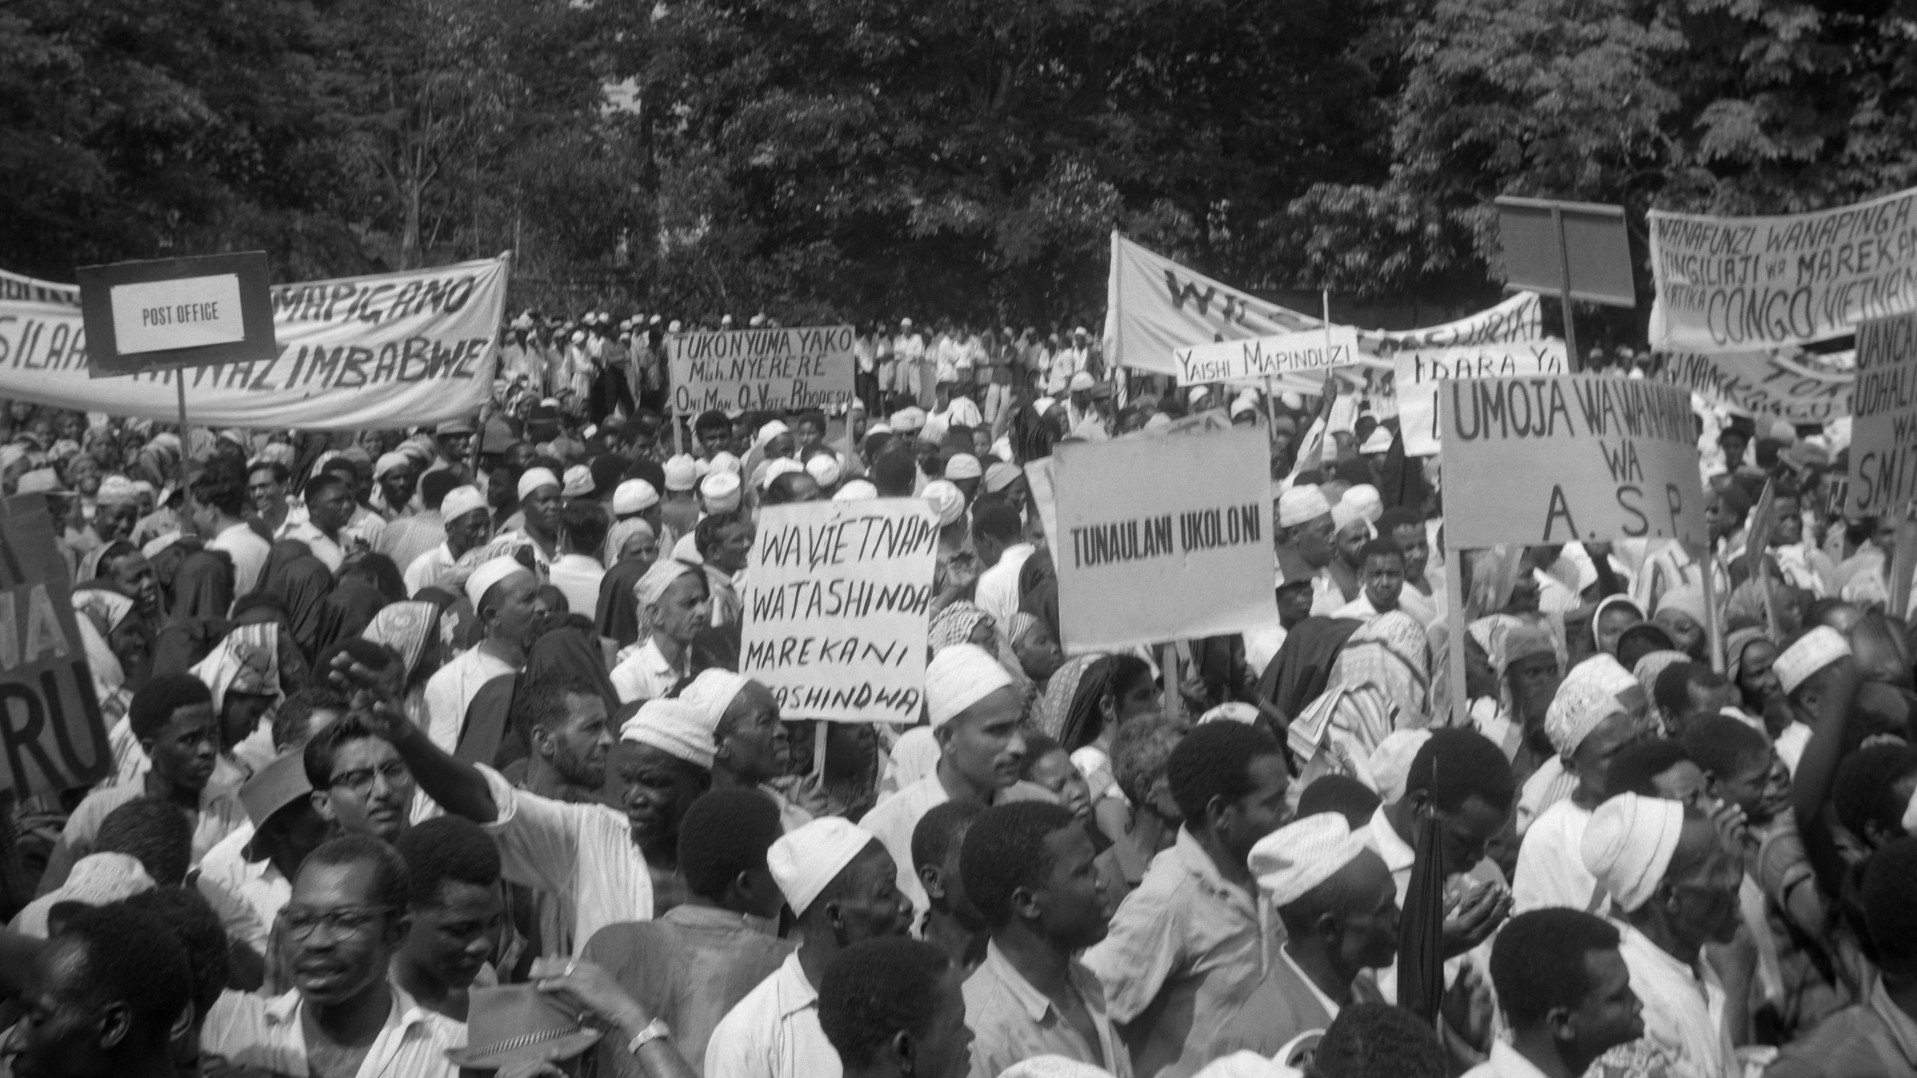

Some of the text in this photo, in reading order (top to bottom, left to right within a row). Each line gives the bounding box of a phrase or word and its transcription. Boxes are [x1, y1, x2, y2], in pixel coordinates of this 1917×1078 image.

[1658, 195, 1912, 254] WANAFUNZI WANAPINGA
[143, 302, 219, 327] POST OFFICE
[1708, 286, 1814, 347] CONGO
[799, 329, 851, 353] YAKO
[731, 353, 826, 382] NYERERE
[1855, 362, 1917, 417] UDHALI
[1453, 378, 1575, 441] UMOJA
[1600, 439, 1644, 483] WA
[1071, 502, 1261, 569] TUNAULANI UKOLONI
[753, 579, 932, 624] WATASHINDA
[745, 635, 909, 672] MAREKANI
[769, 681, 920, 717] ASHINDWA
